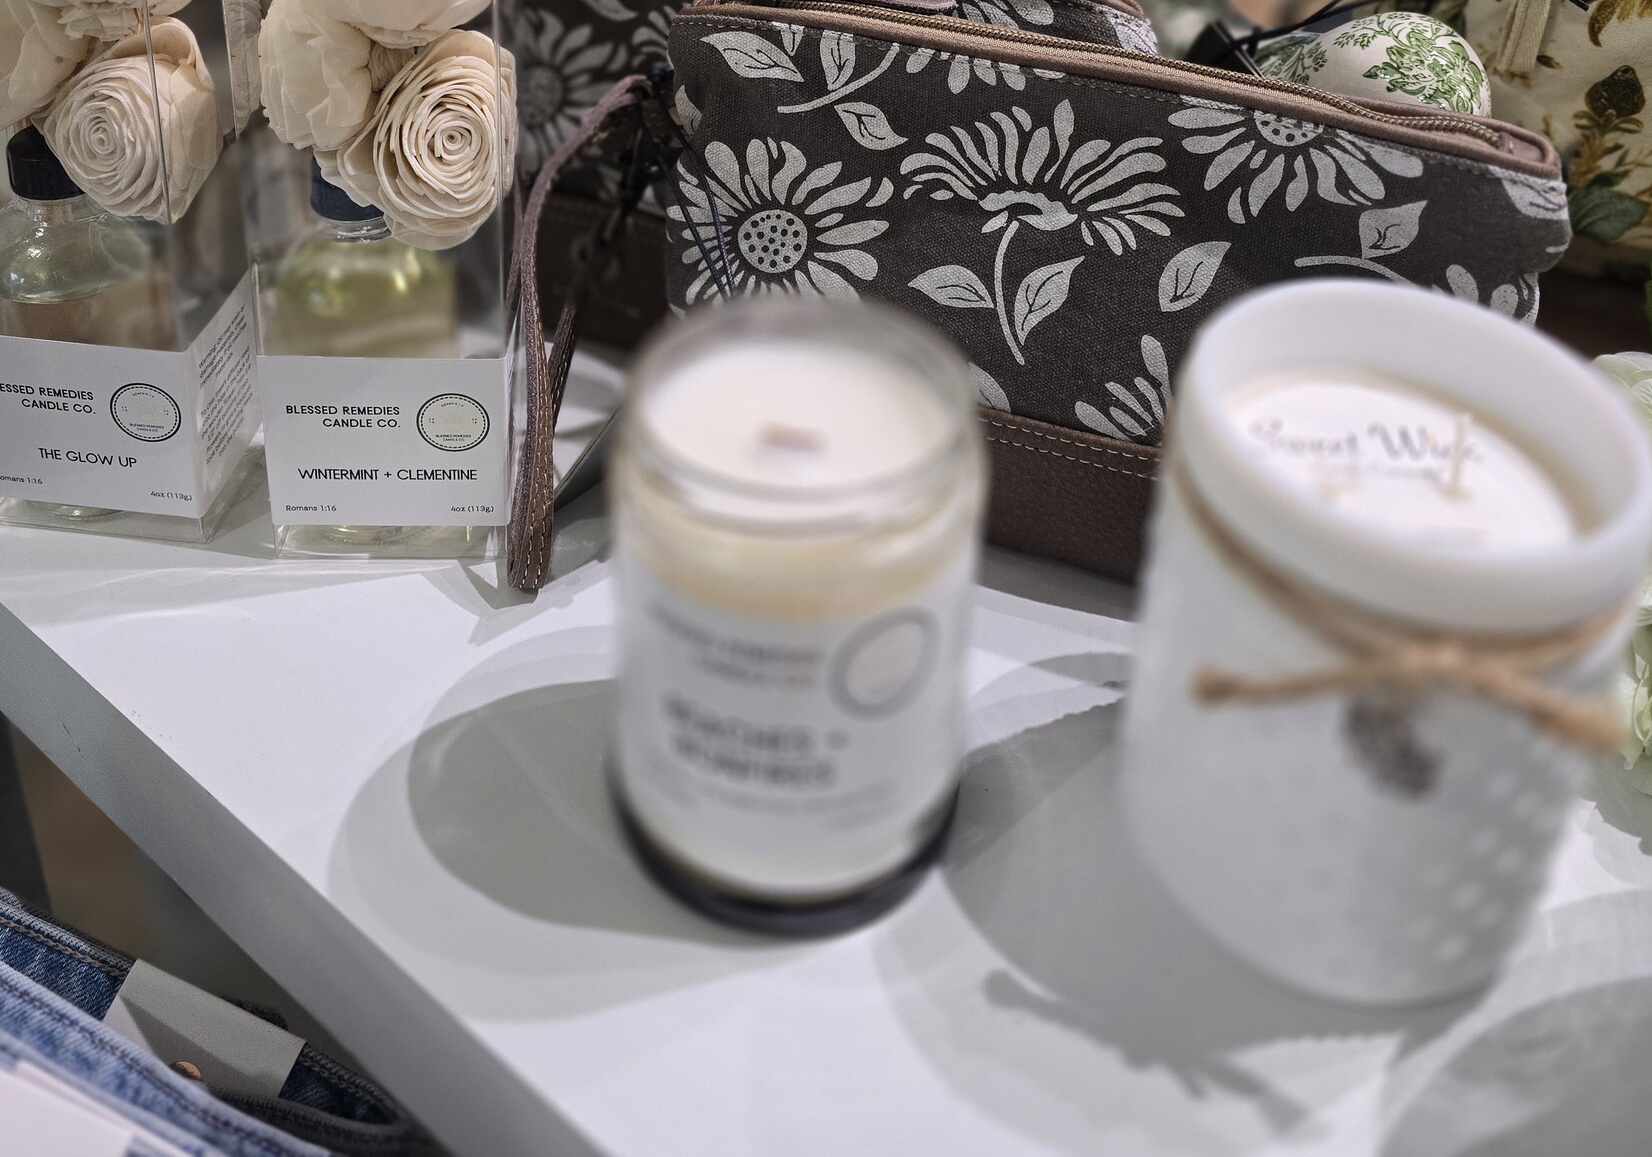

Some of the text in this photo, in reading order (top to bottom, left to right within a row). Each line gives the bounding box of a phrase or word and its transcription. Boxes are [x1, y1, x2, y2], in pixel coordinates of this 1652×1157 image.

[0, 382, 94, 401] ESSED REMEDIES
[21, 398, 97, 415] CANDLE CO.
[285, 404, 400, 416] BLESSED REMEDIES
[322, 418, 401, 428] CANDLE CO.
[38, 447, 138, 468] THE GLOW UP
[0, 475, 43, 485] omans 1:16
[297, 468, 478, 481] WINTERMINT + CLEMENTINE
[285, 504, 337, 512] Romans 1:16
